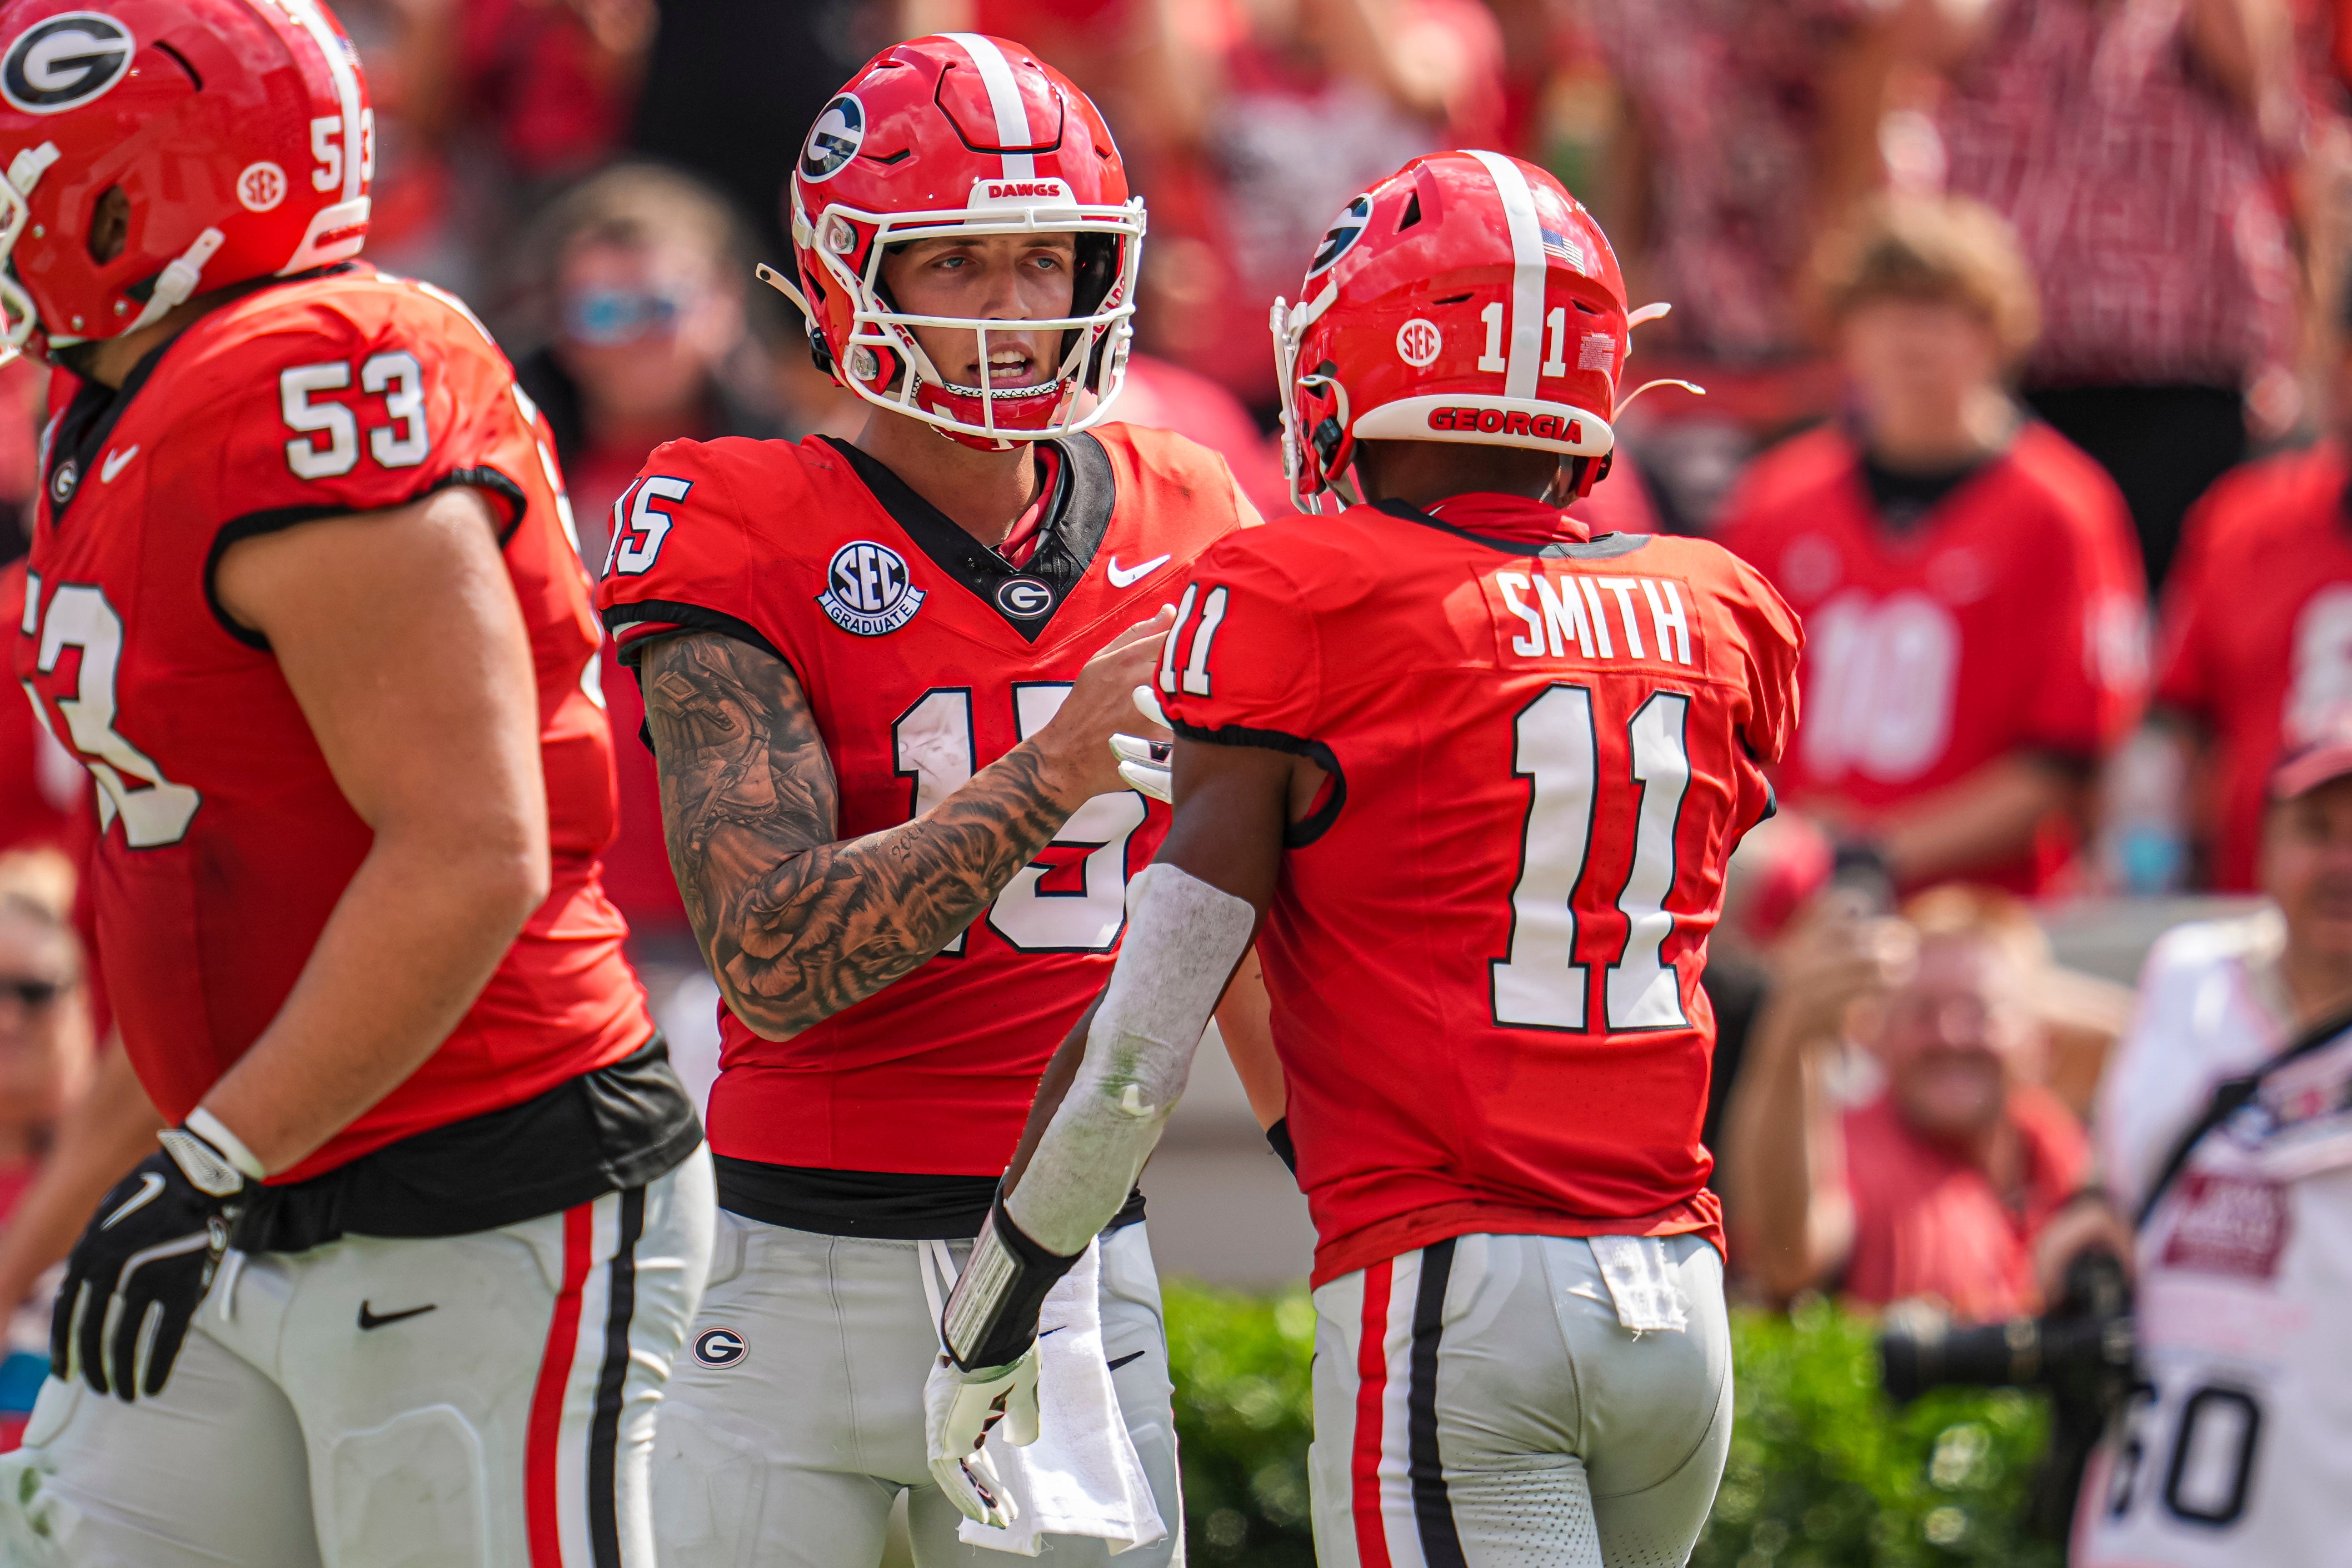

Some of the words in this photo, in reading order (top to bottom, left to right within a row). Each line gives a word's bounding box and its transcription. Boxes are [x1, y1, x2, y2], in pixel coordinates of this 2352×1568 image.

[4, 17, 127, 107] G
[310, 108, 376, 193] 53
[800, 97, 862, 177] G
[245, 169, 278, 204] SEC
[988, 184, 1060, 198] DAWGS
[1402, 324, 1435, 360] SEC
[1477, 301, 1566, 377] 11
[280, 349, 431, 481] 53
[1427, 406, 1582, 445] GEORGIA
[600, 475, 695, 582] 15
[835, 546, 902, 611] SEC
[1000, 582, 1049, 614] G
[831, 603, 913, 633] GRADUATE
[1159, 581, 1230, 699] 11
[1495, 572, 1691, 666] SMITH
[1487, 680, 1694, 1033] 11
[695, 1330, 743, 1364] G
